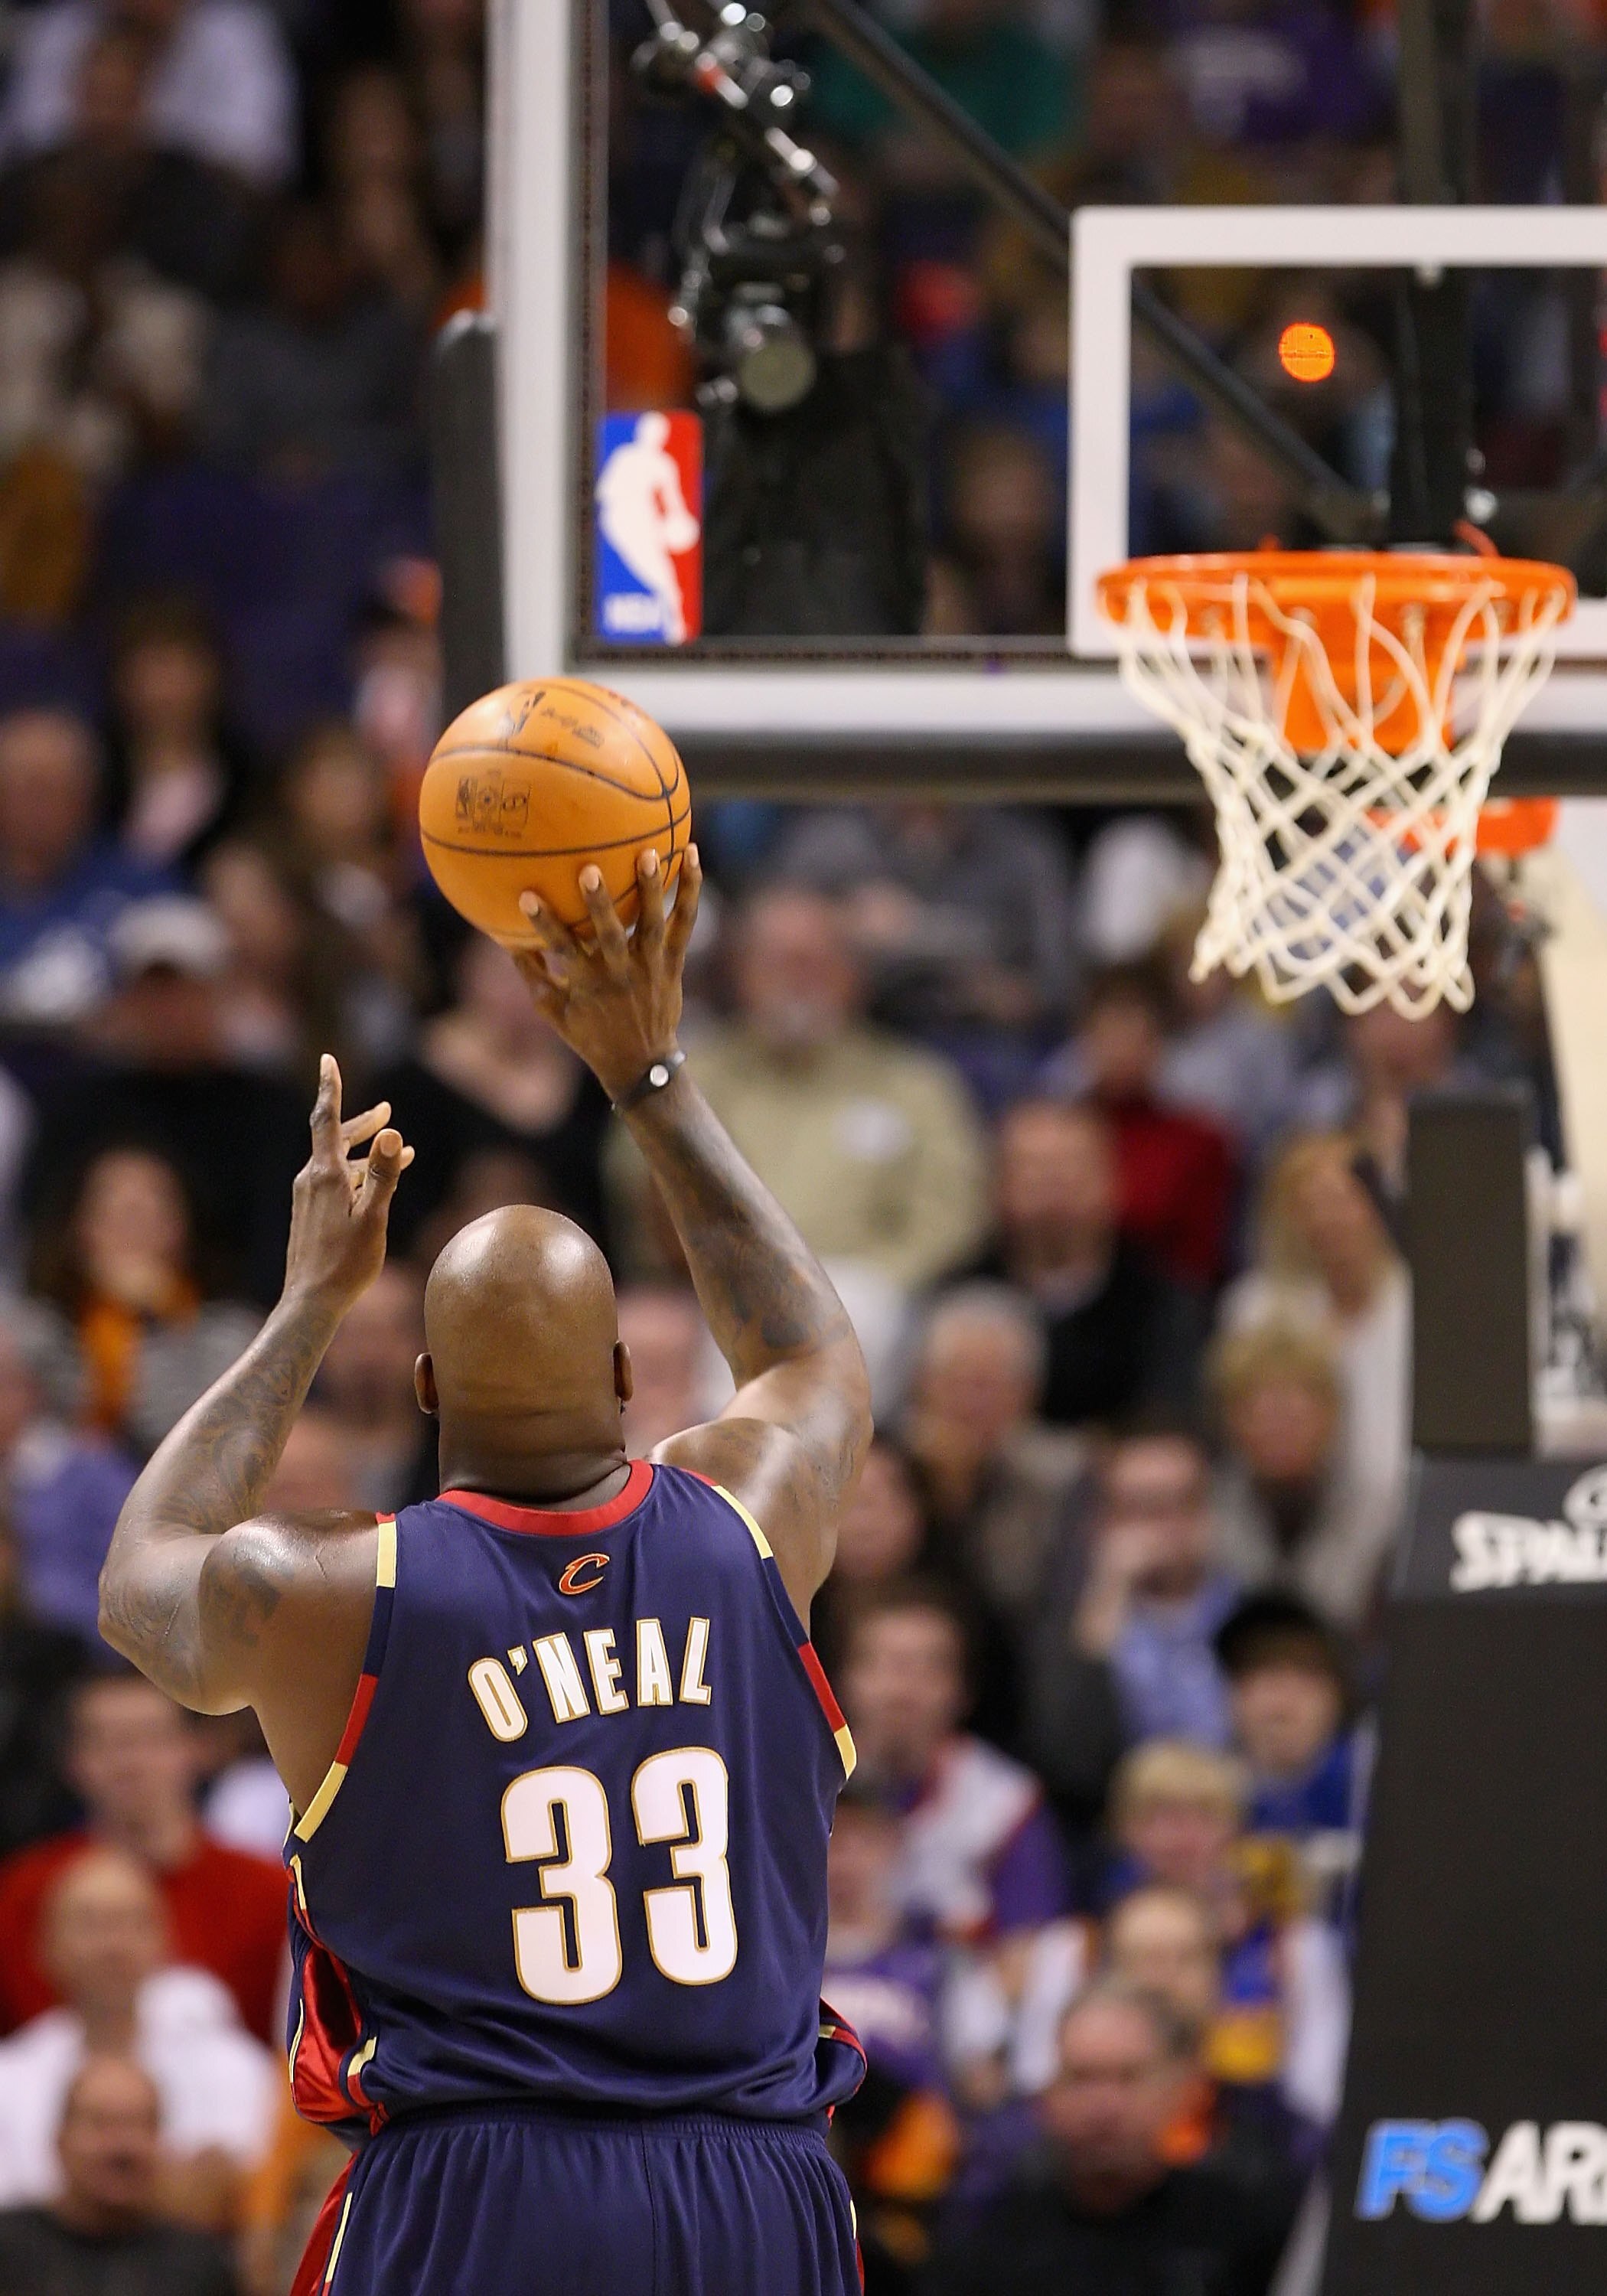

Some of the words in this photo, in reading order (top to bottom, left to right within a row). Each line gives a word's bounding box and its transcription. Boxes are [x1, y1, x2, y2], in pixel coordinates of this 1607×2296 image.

[467, 1616, 712, 1742] O'NEAL
[500, 1746, 739, 2006] 33
[1354, 2117, 1490, 2223] FS
